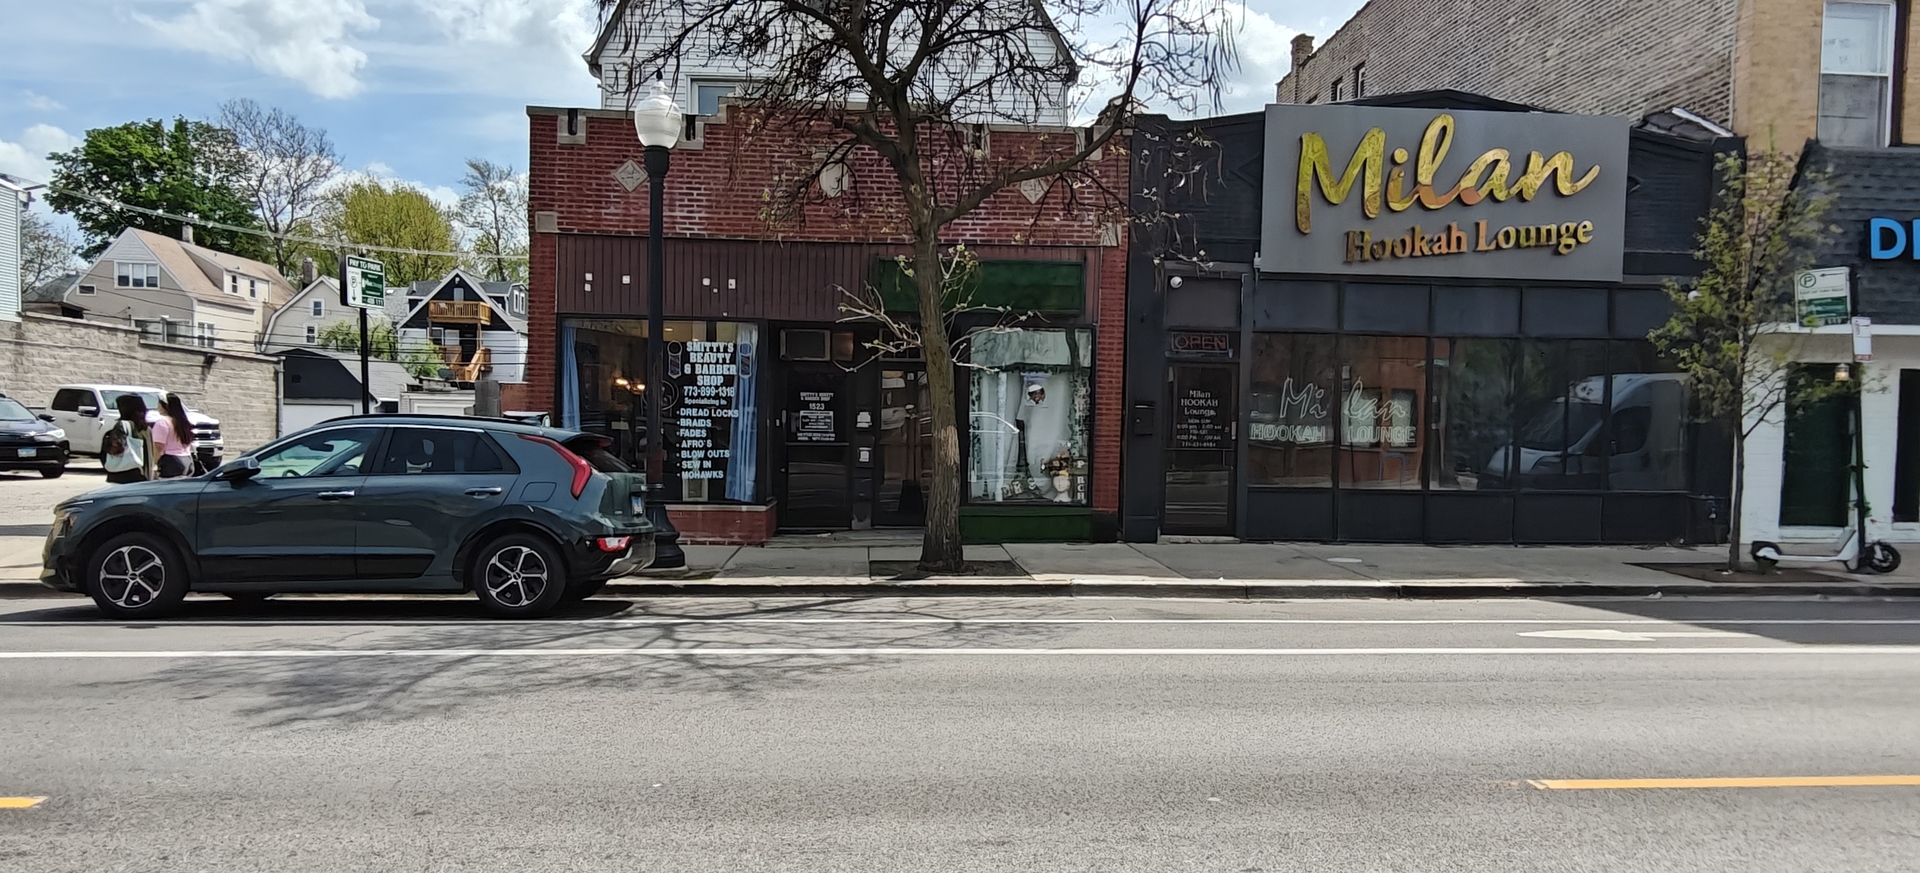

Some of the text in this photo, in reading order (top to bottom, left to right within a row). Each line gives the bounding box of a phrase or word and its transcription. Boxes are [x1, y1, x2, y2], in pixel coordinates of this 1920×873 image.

[1296, 113, 1601, 235] Milan
[1342, 218, 1595, 266] Hookah Lounge
[349, 258, 382, 272] PAY TO PARK
[686, 341, 734, 352] SMITTY'S
[1175, 335, 1226, 349] OPEN
[690, 352, 731, 363] BEAUTY
[684, 363, 737, 375] & BARBER
[697, 375, 724, 386] SHOP
[683, 386, 735, 397] 773-899-1318
[1189, 390, 1211, 398] Milan
[809, 402, 825, 410] 1523
[1180, 398, 1219, 407] HOOKAH
[680, 408, 739, 417] DREAD LOCKS
[680, 418, 712, 427] BRAIDS
[680, 429, 707, 437] FADES
[1250, 423, 1417, 443] HOOKAH LOUNGE
[681, 450, 730, 459] BLOW OUTS
[681, 460, 712, 469] SEW IN
[681, 470, 724, 479] MOHAWKS
